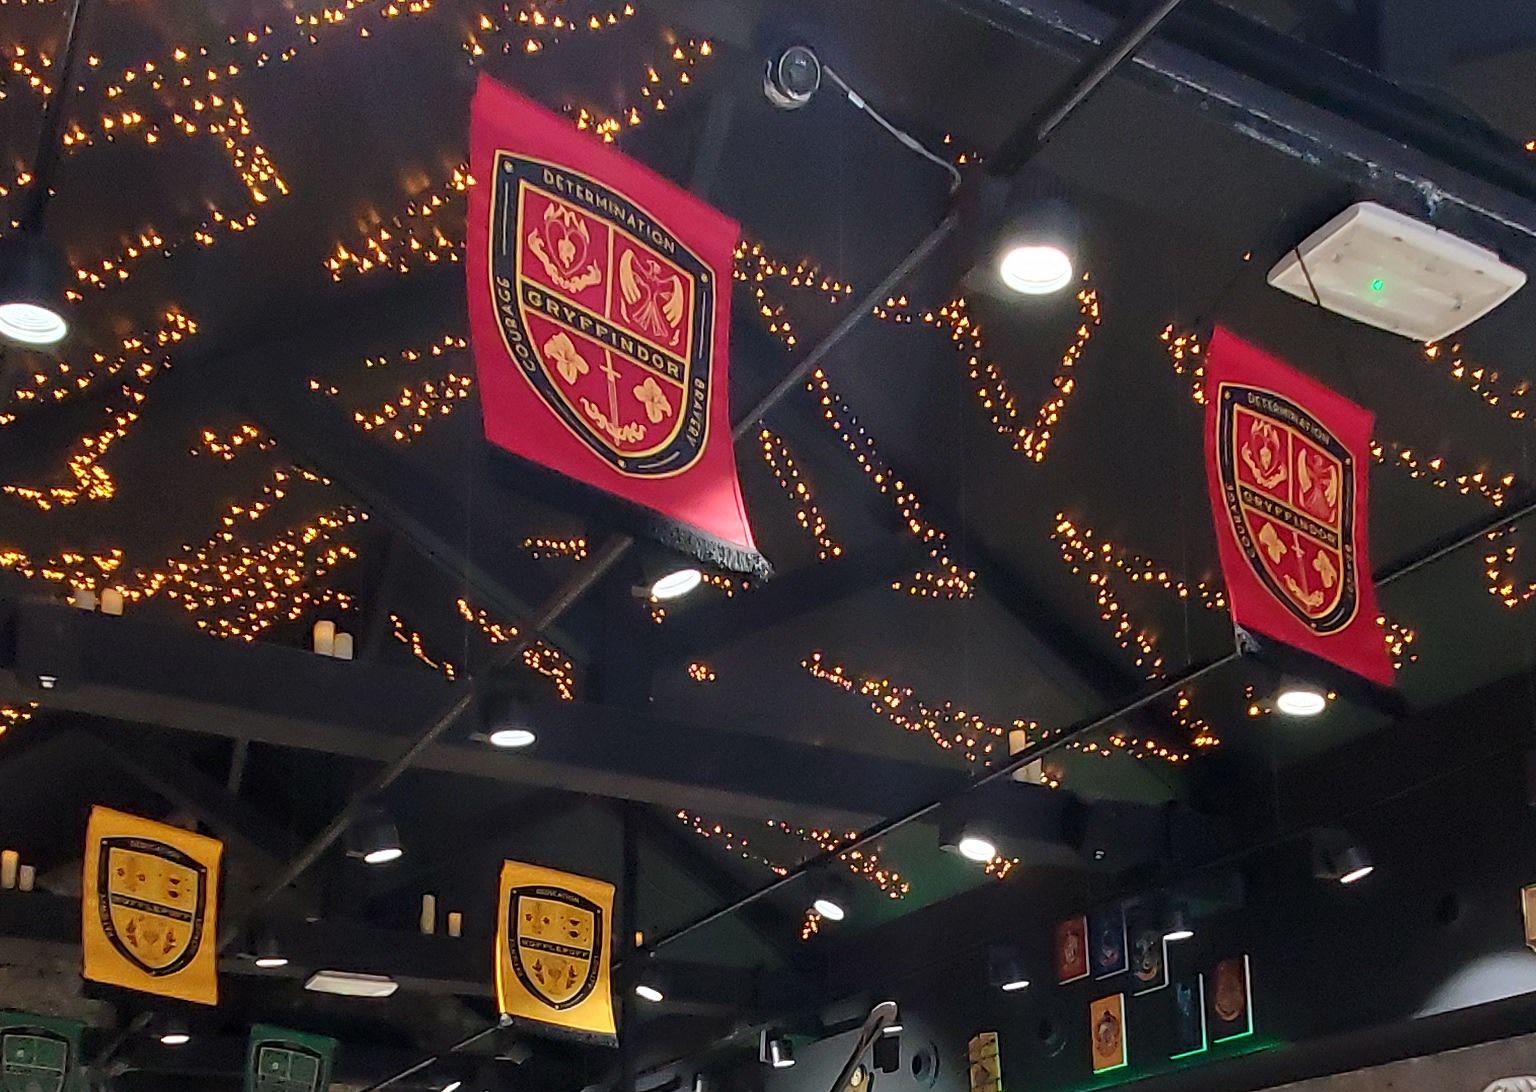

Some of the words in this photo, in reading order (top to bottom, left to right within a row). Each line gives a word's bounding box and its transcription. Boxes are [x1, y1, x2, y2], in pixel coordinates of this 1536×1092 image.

[543, 167, 675, 254] DETERMINATION
[495, 276, 537, 373] COURAGE
[526, 289, 681, 378] GRYFFINDOR
[689, 377, 706, 448] BRAVERY
[1243, 490, 1338, 544] GRYFFINDOR
